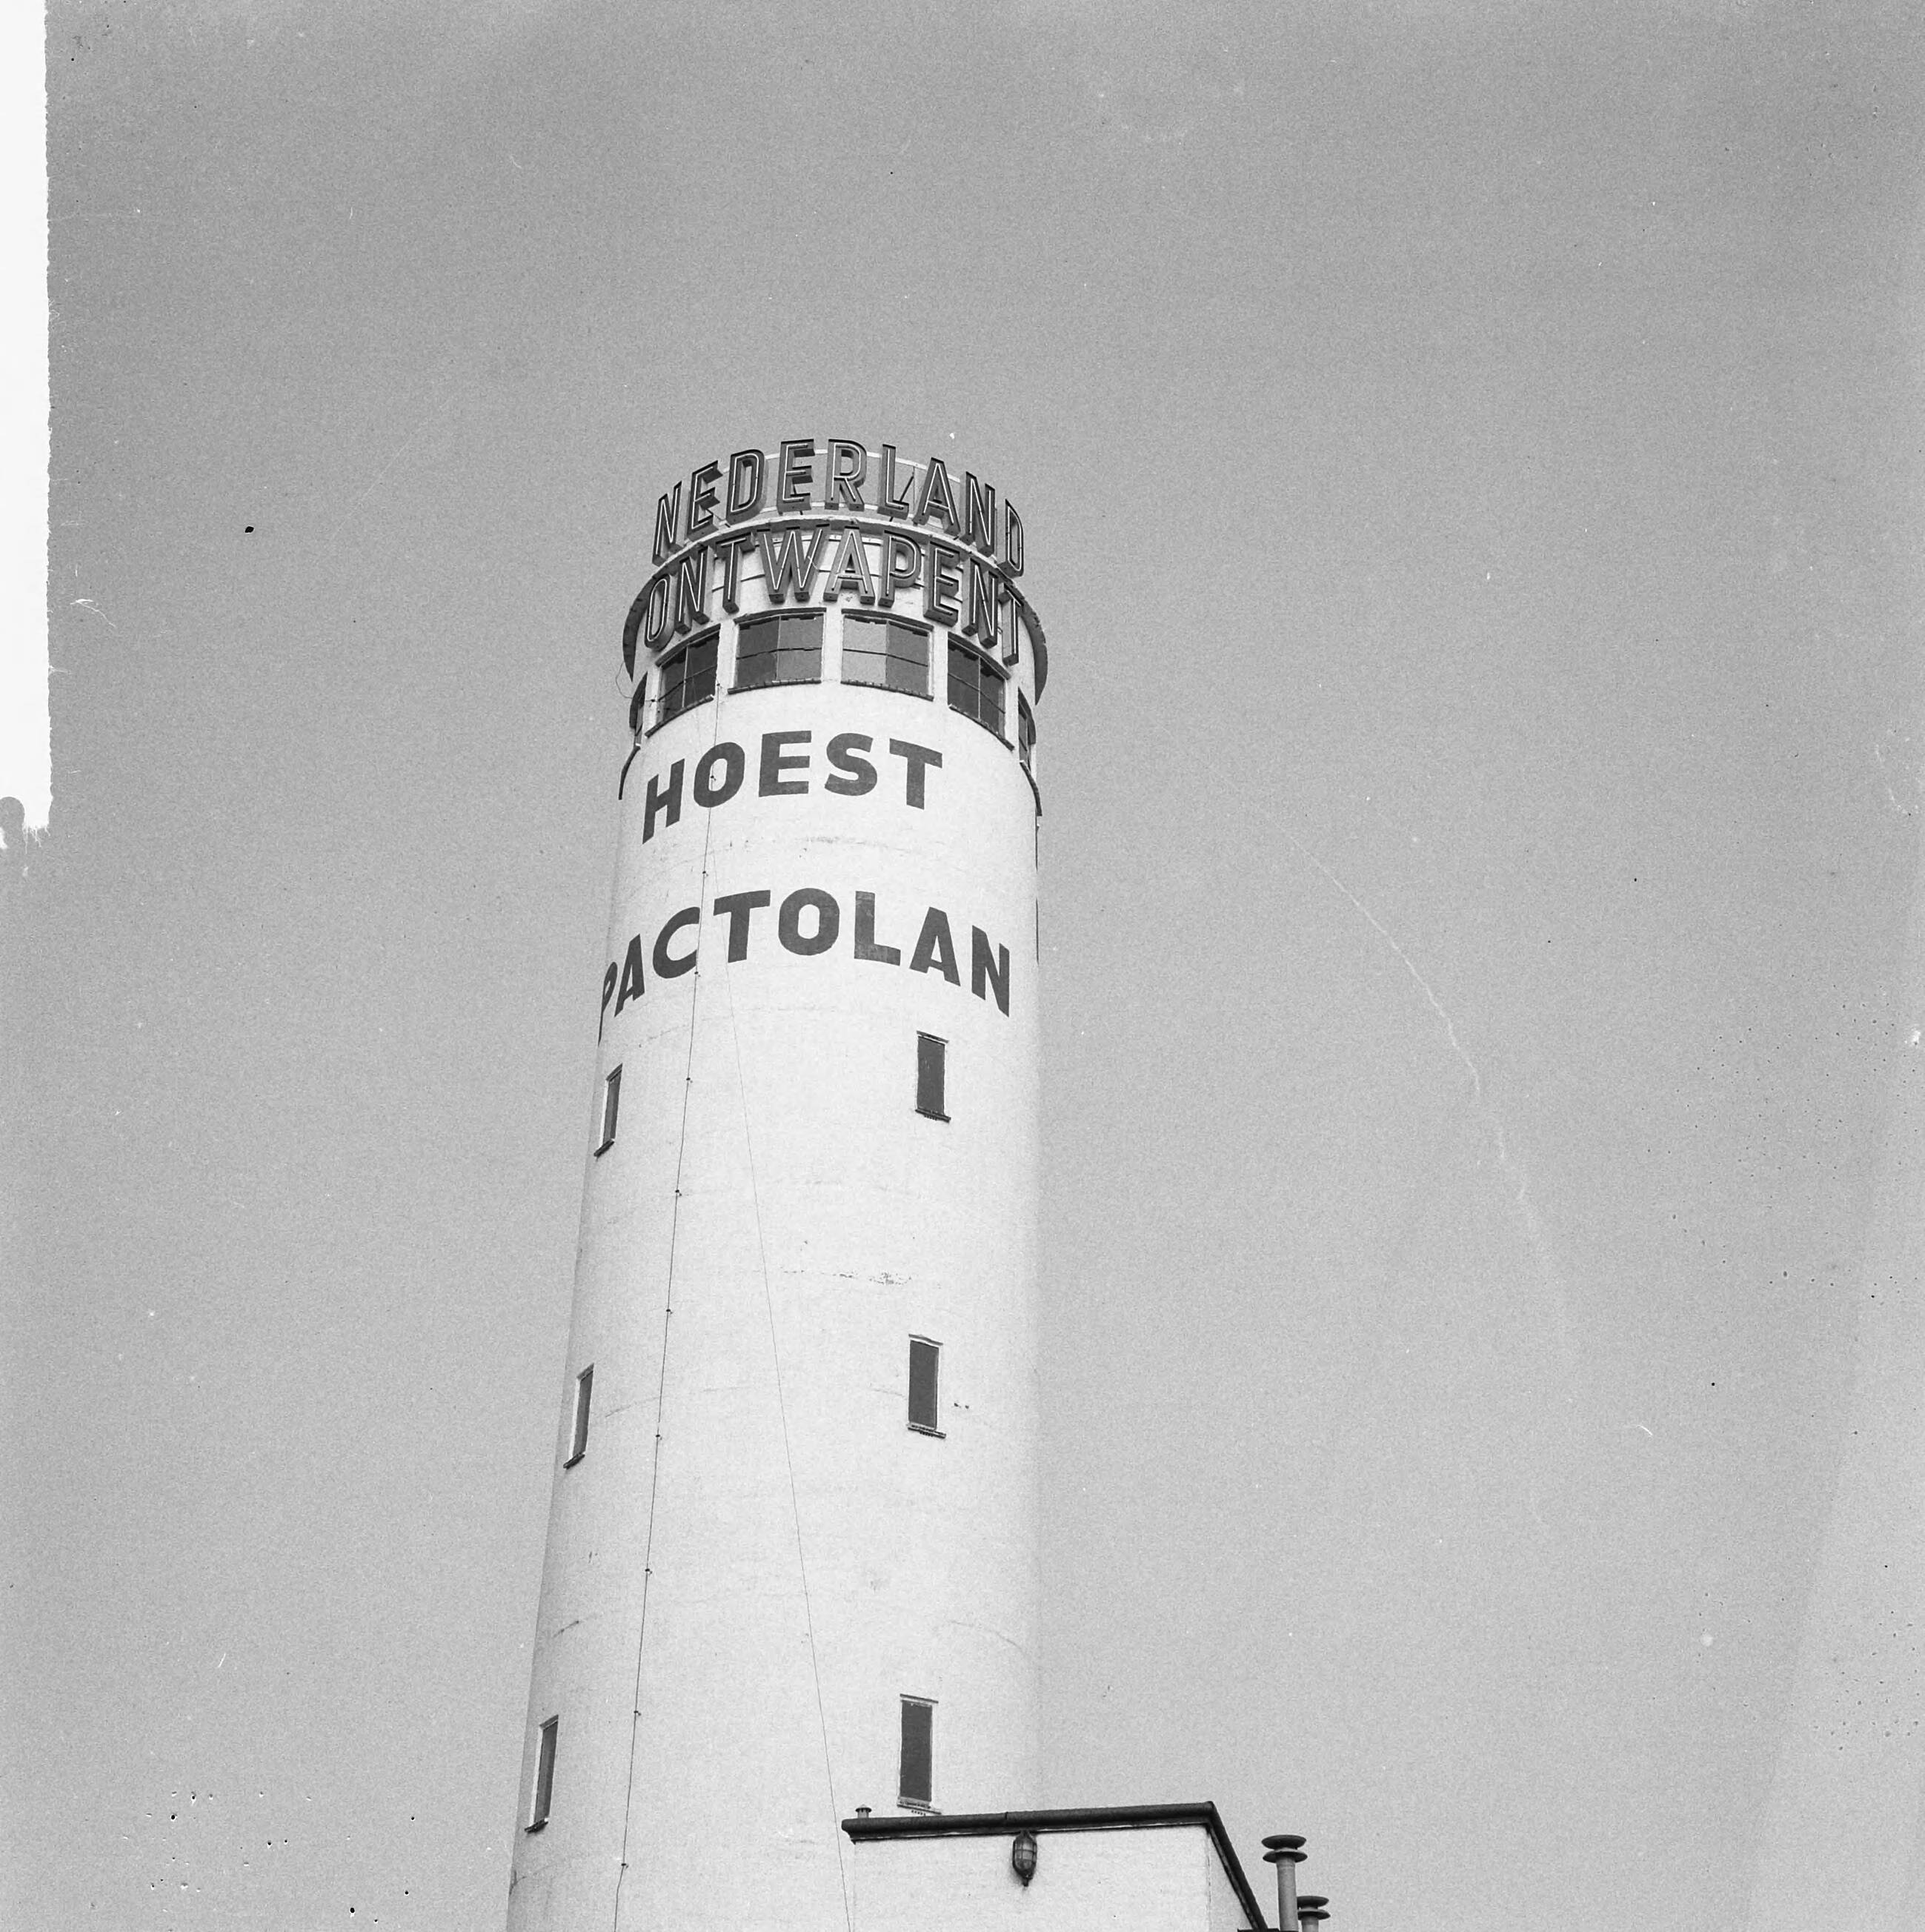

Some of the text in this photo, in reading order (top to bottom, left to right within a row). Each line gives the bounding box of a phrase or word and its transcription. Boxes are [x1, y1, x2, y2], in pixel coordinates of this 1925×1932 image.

[652, 438, 1024, 577] NEDERLAND
[644, 524, 1023, 665] ONTWAPENT
[643, 730, 942, 844] HOEST
[598, 888, 1010, 1045] PACTOLAN
